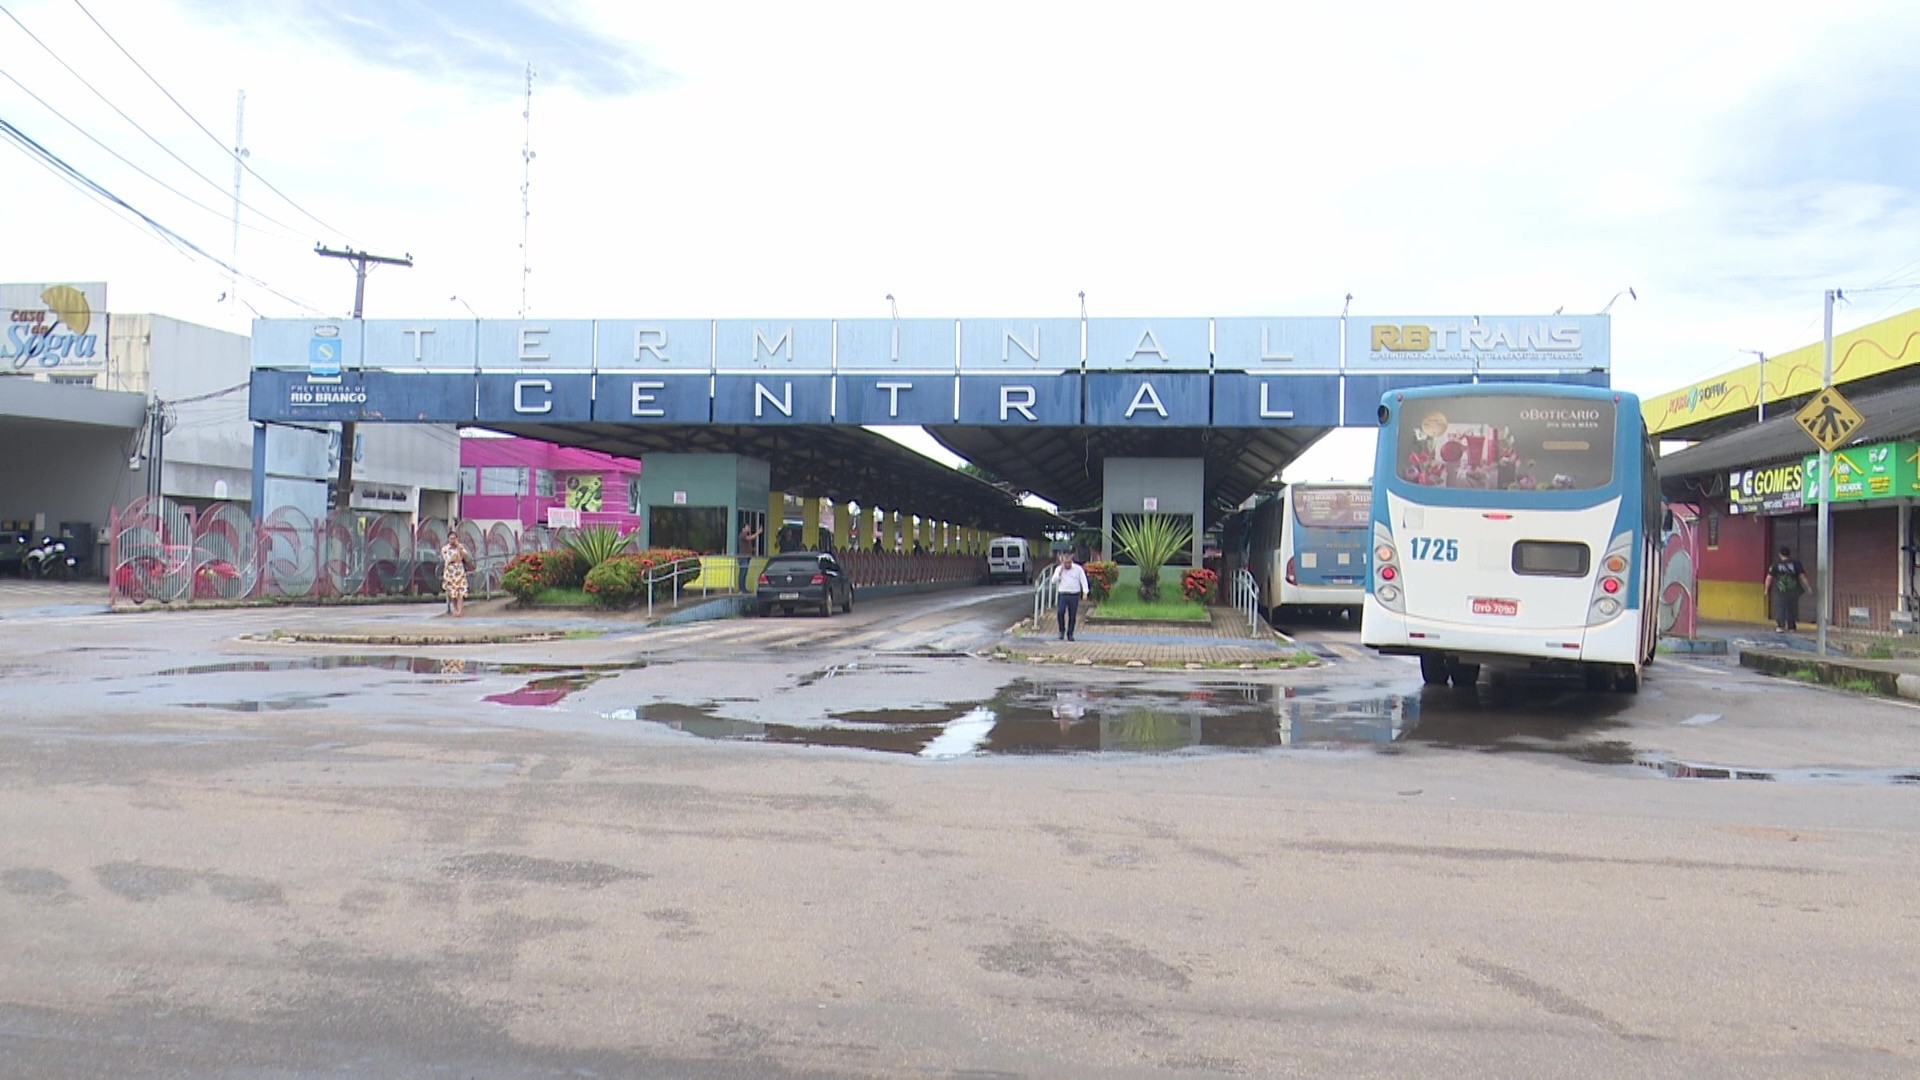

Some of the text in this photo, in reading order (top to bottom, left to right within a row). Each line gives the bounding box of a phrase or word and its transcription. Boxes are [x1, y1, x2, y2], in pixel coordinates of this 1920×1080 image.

[402, 325, 1294, 362] TERMINAL
[1371, 324, 1582, 351] RBTRANS
[291, 393, 367, 402] RIO BRANCO
[513, 378, 1294, 421] CENTRAL
[1754, 464, 1802, 495] GOMES
[1410, 537, 1459, 562] 1725
